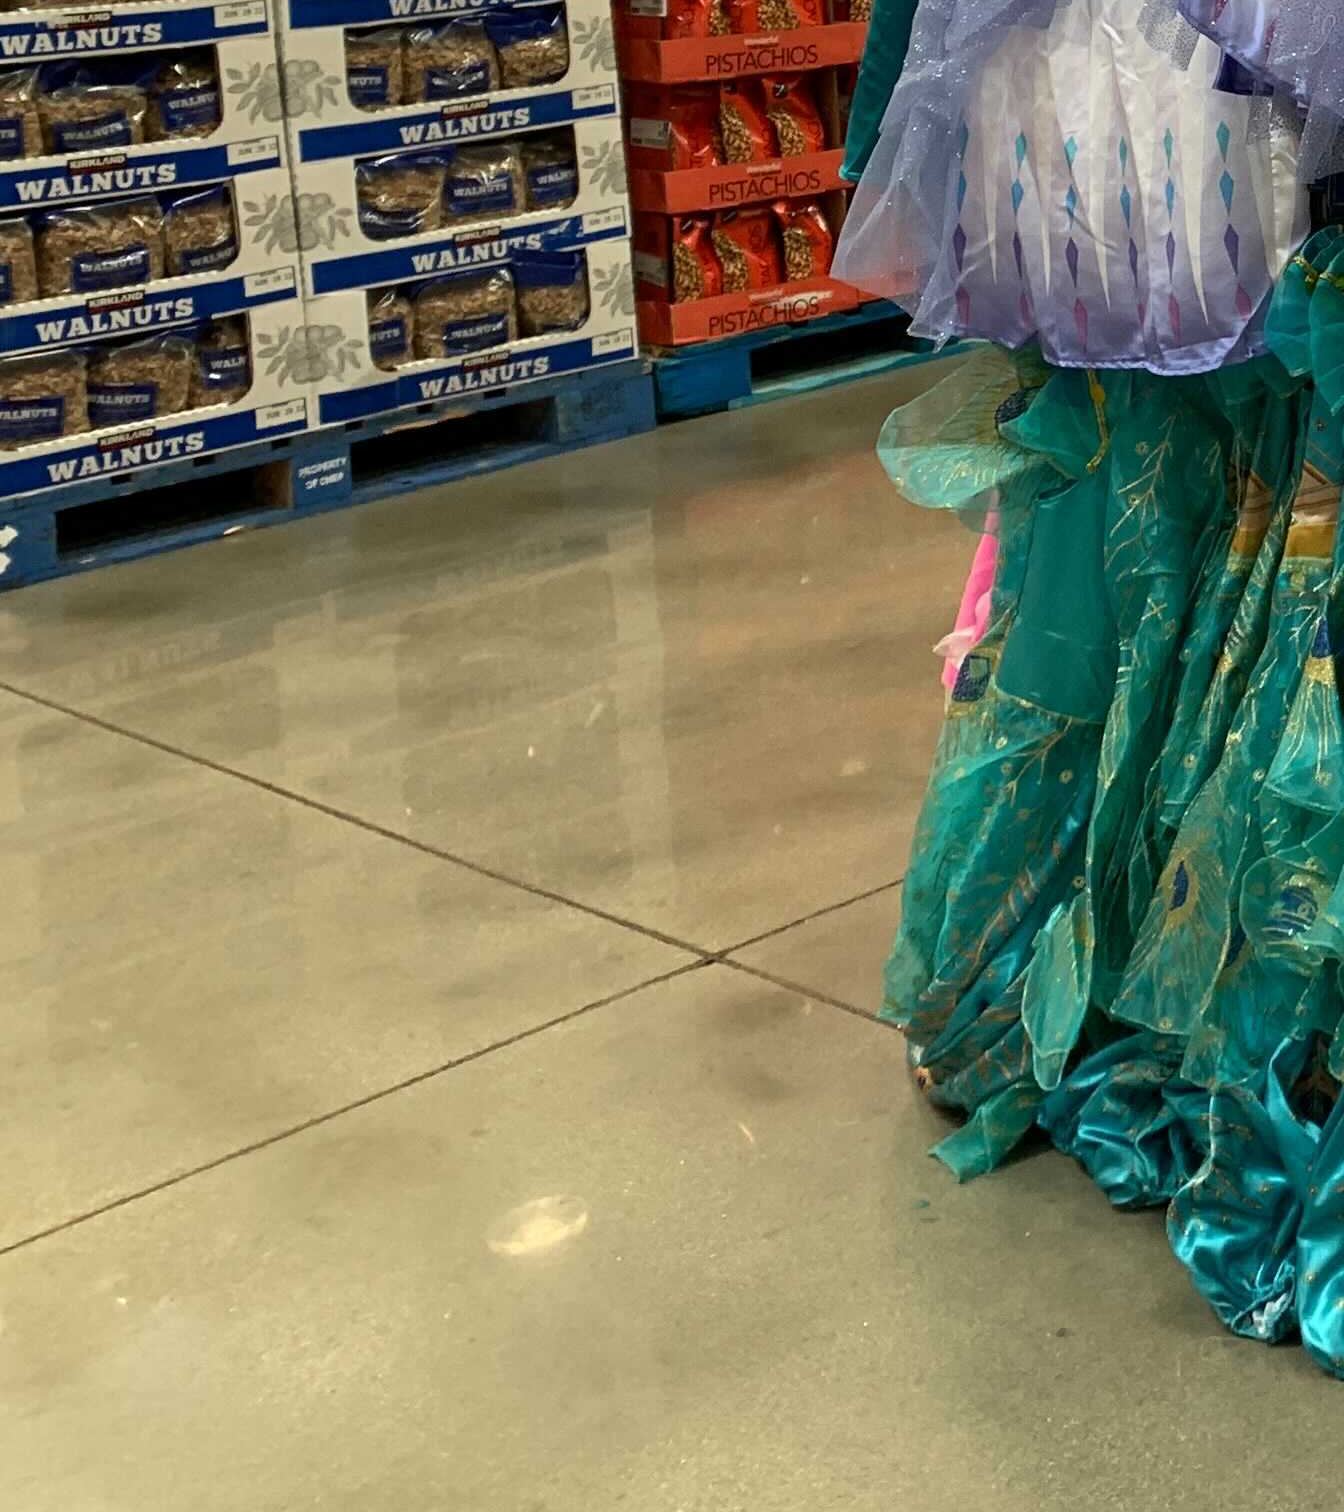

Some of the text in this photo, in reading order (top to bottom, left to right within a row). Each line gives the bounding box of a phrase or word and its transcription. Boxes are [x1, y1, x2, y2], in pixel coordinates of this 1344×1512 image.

[1, 22, 163, 57] WALNUTS
[706, 44, 819, 75] PISTACHIOS
[62, 121, 124, 141] WALNUTS
[400, 107, 531, 145] WALNUTS
[69, 155, 126, 170] KIRKLAND
[16, 163, 177, 202] WALNUTS
[709, 170, 820, 202] PISTACHIOS
[412, 233, 542, 273] WALNUTS
[36, 297, 195, 343] WALNUTS
[708, 296, 820, 337] PISTACHIOS
[420, 356, 549, 399] WALNUTS
[47, 432, 205, 483] WALNUTS
